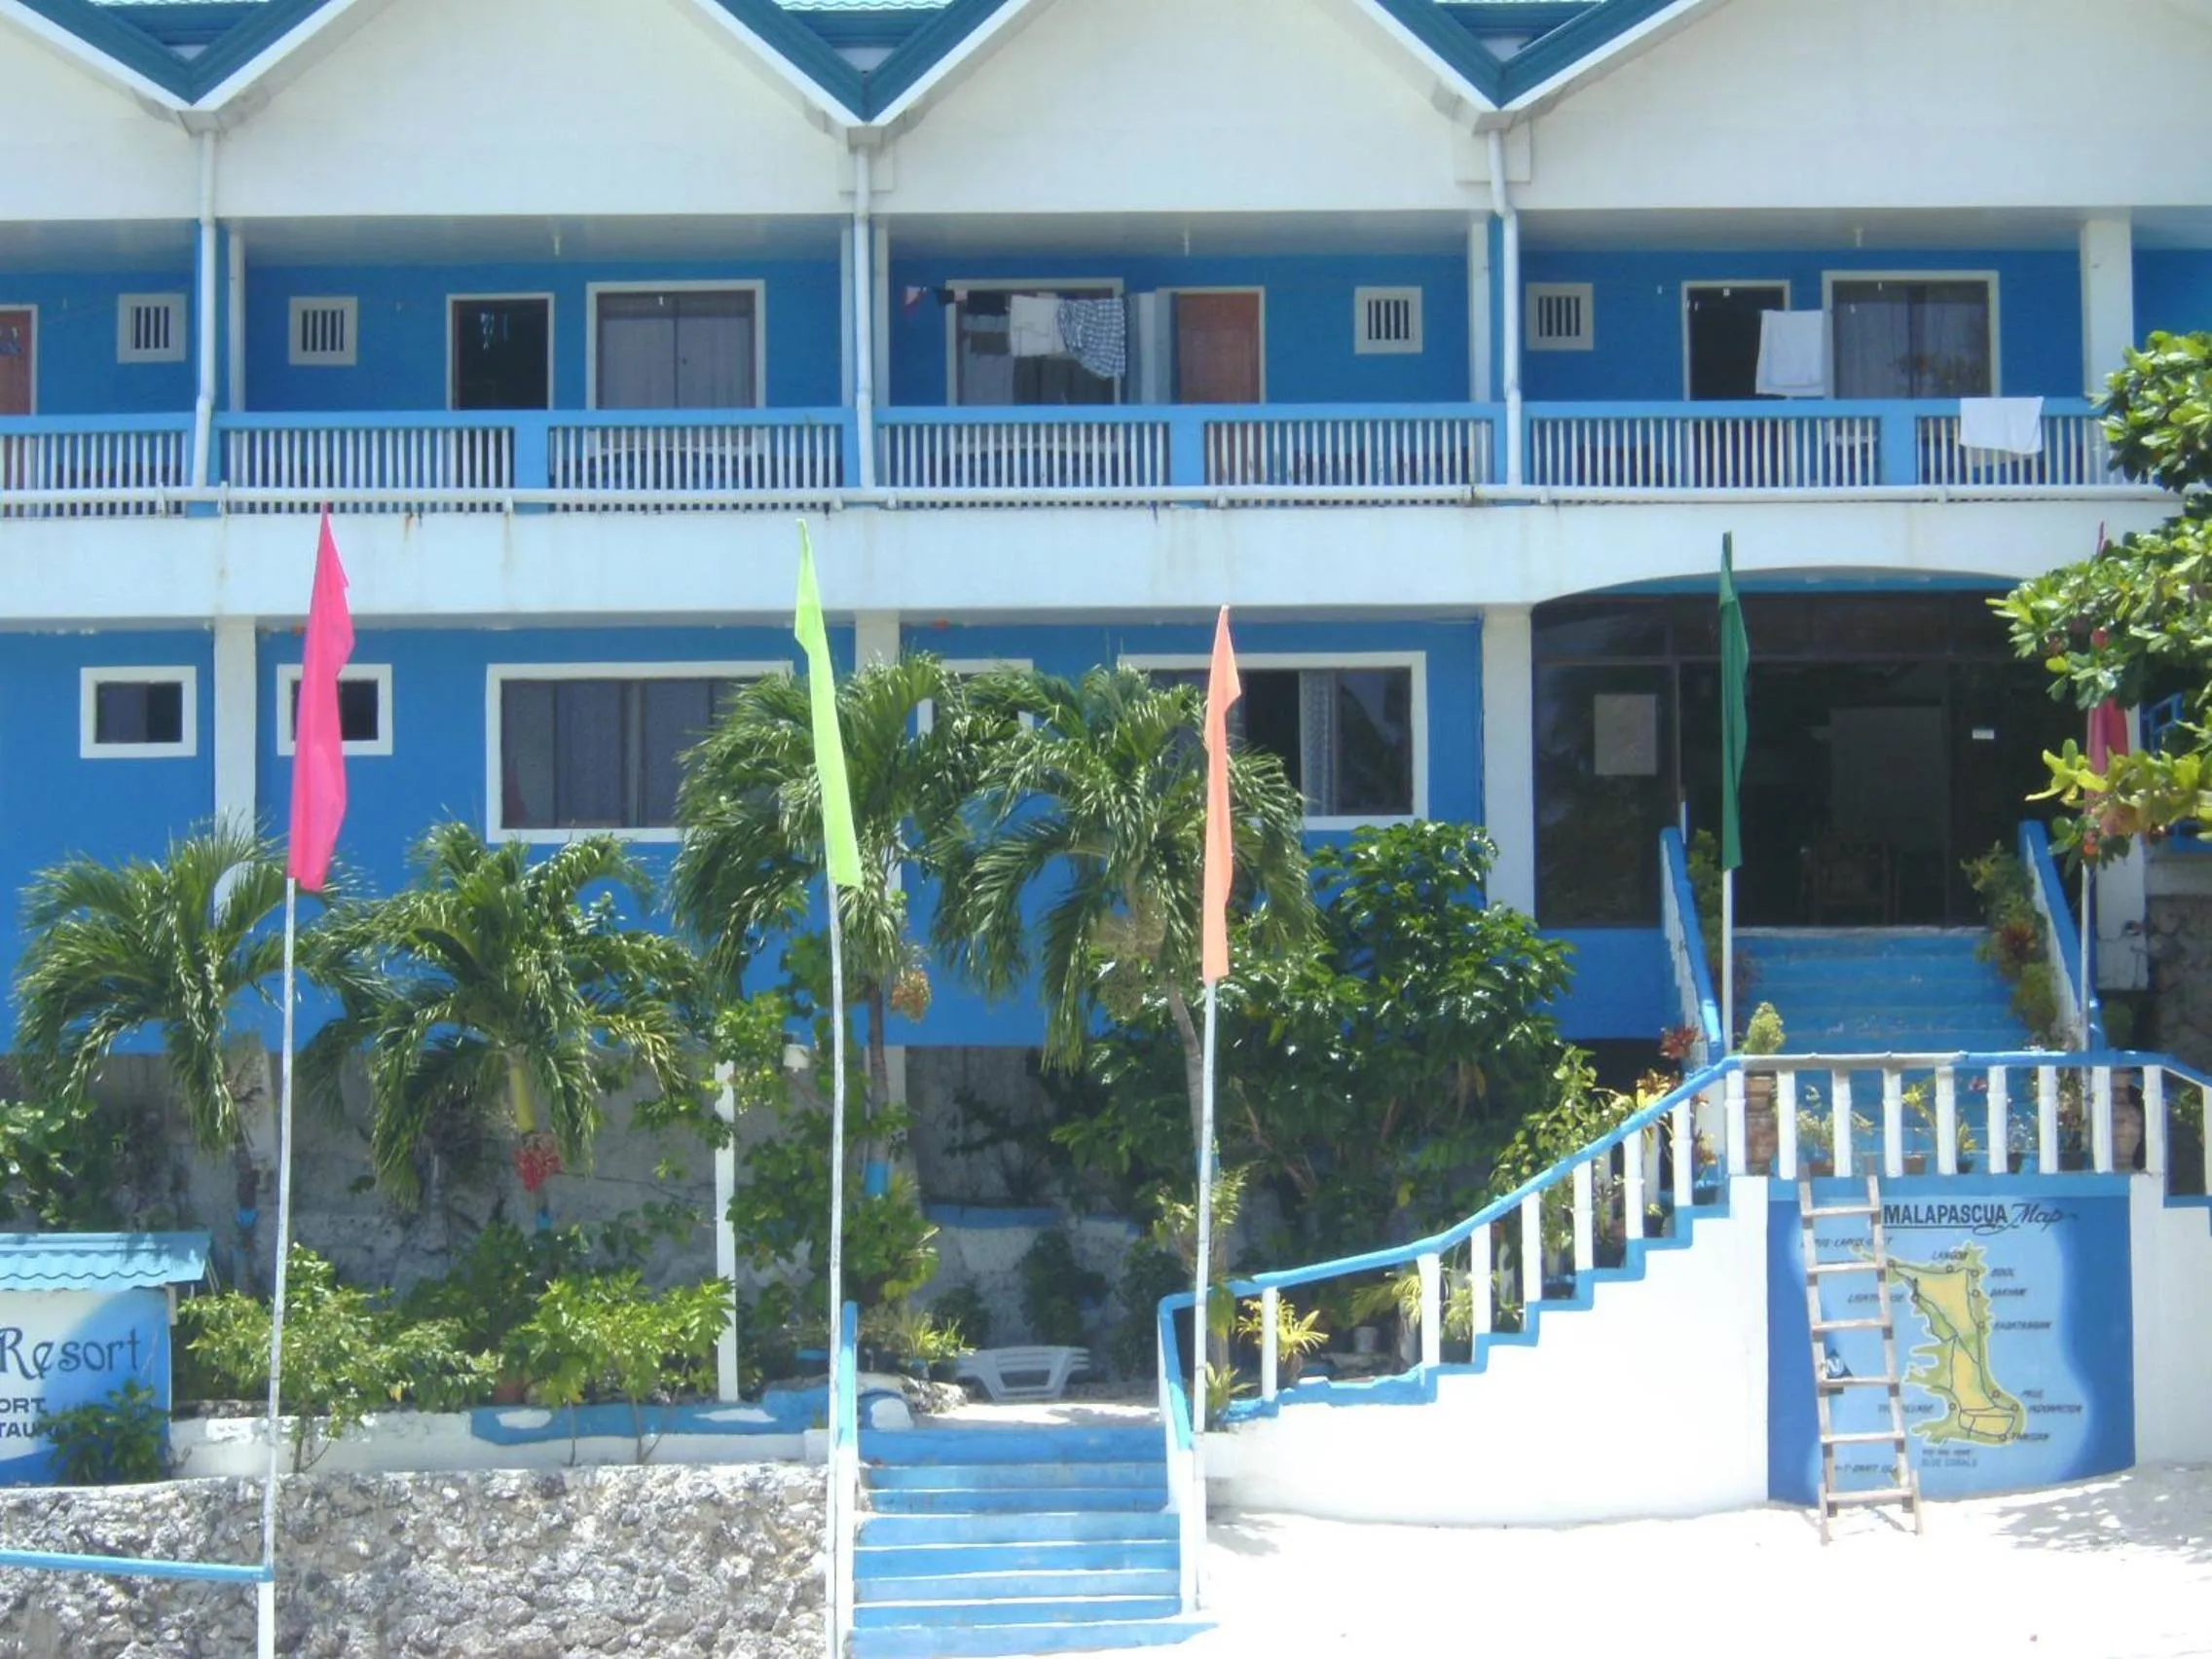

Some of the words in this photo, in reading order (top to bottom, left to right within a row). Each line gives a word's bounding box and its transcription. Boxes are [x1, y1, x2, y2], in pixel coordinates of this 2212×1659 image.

[1883, 1204, 2008, 1226] MALAPASCUA
[2008, 1202, 2068, 1232] Map
[0, 1326, 140, 1380] Resort
